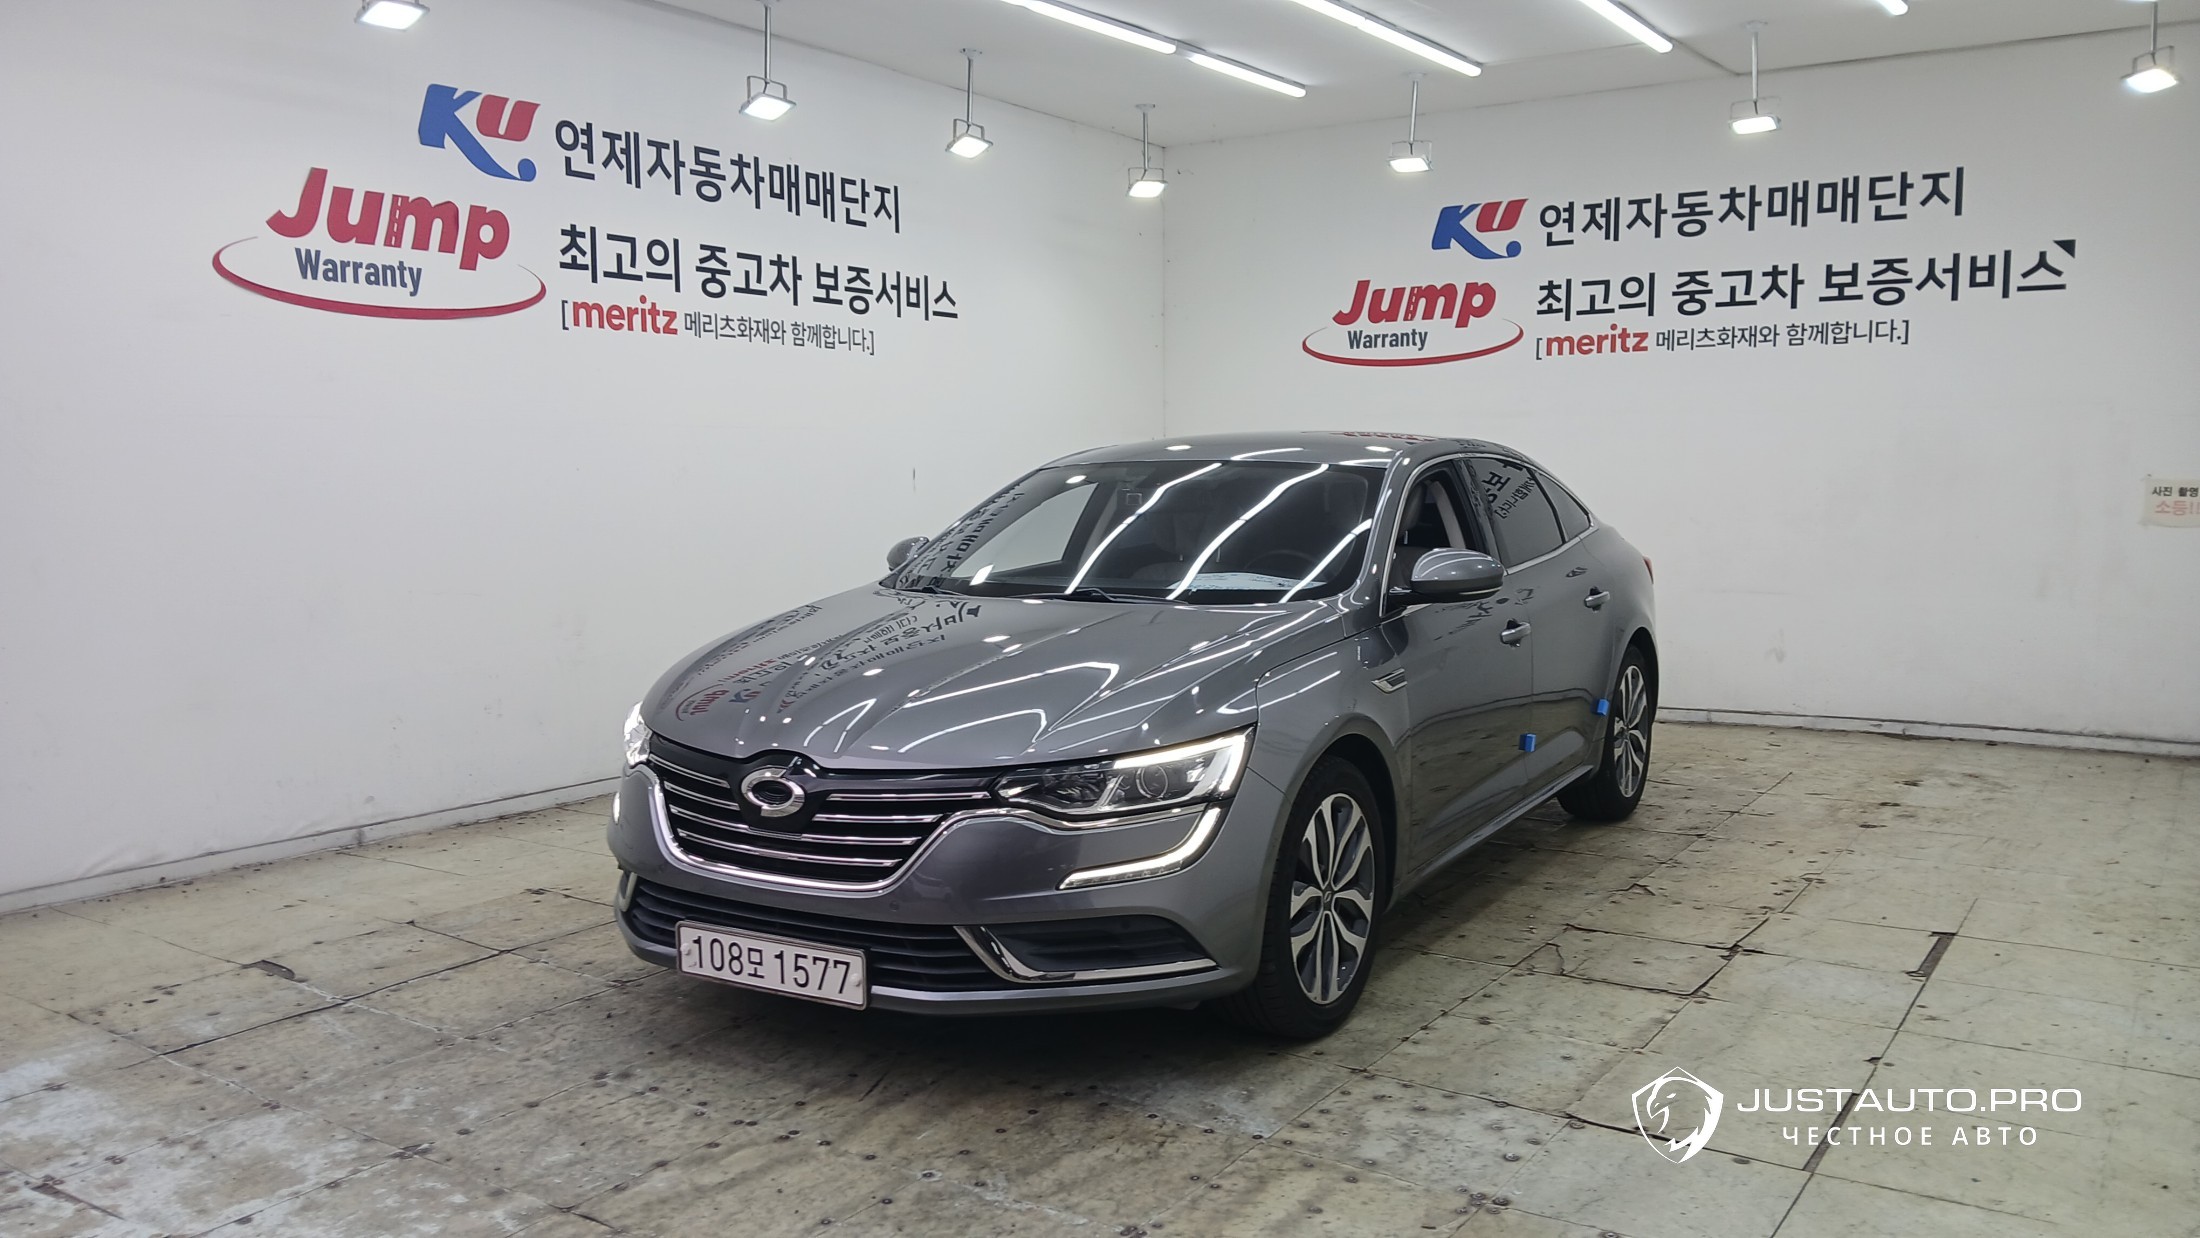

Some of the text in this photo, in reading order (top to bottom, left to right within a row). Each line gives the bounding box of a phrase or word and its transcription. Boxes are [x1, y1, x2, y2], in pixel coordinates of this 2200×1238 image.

[418, 84, 541, 182] KU
[554, 119, 902, 234] 연제자동차매매단지
[1538, 166, 1965, 248] 연제자동차매매단지
[265, 167, 511, 272] Jump
[1431, 198, 1529, 260] KU
[294, 247, 424, 298] Warranty
[558, 223, 960, 322] 최고의 중고차 보증서비스
[1536, 249, 2068, 322] 최고의 중고차 보증서비스
[683, 311, 788, 347] 메리츠화재와
[1332, 279, 1497, 329] Jump
[1346, 328, 1430, 352] Warranty
[1655, 324, 1781, 352] 메리츠화재와
[2152, 486, 2173, 497] 사진
